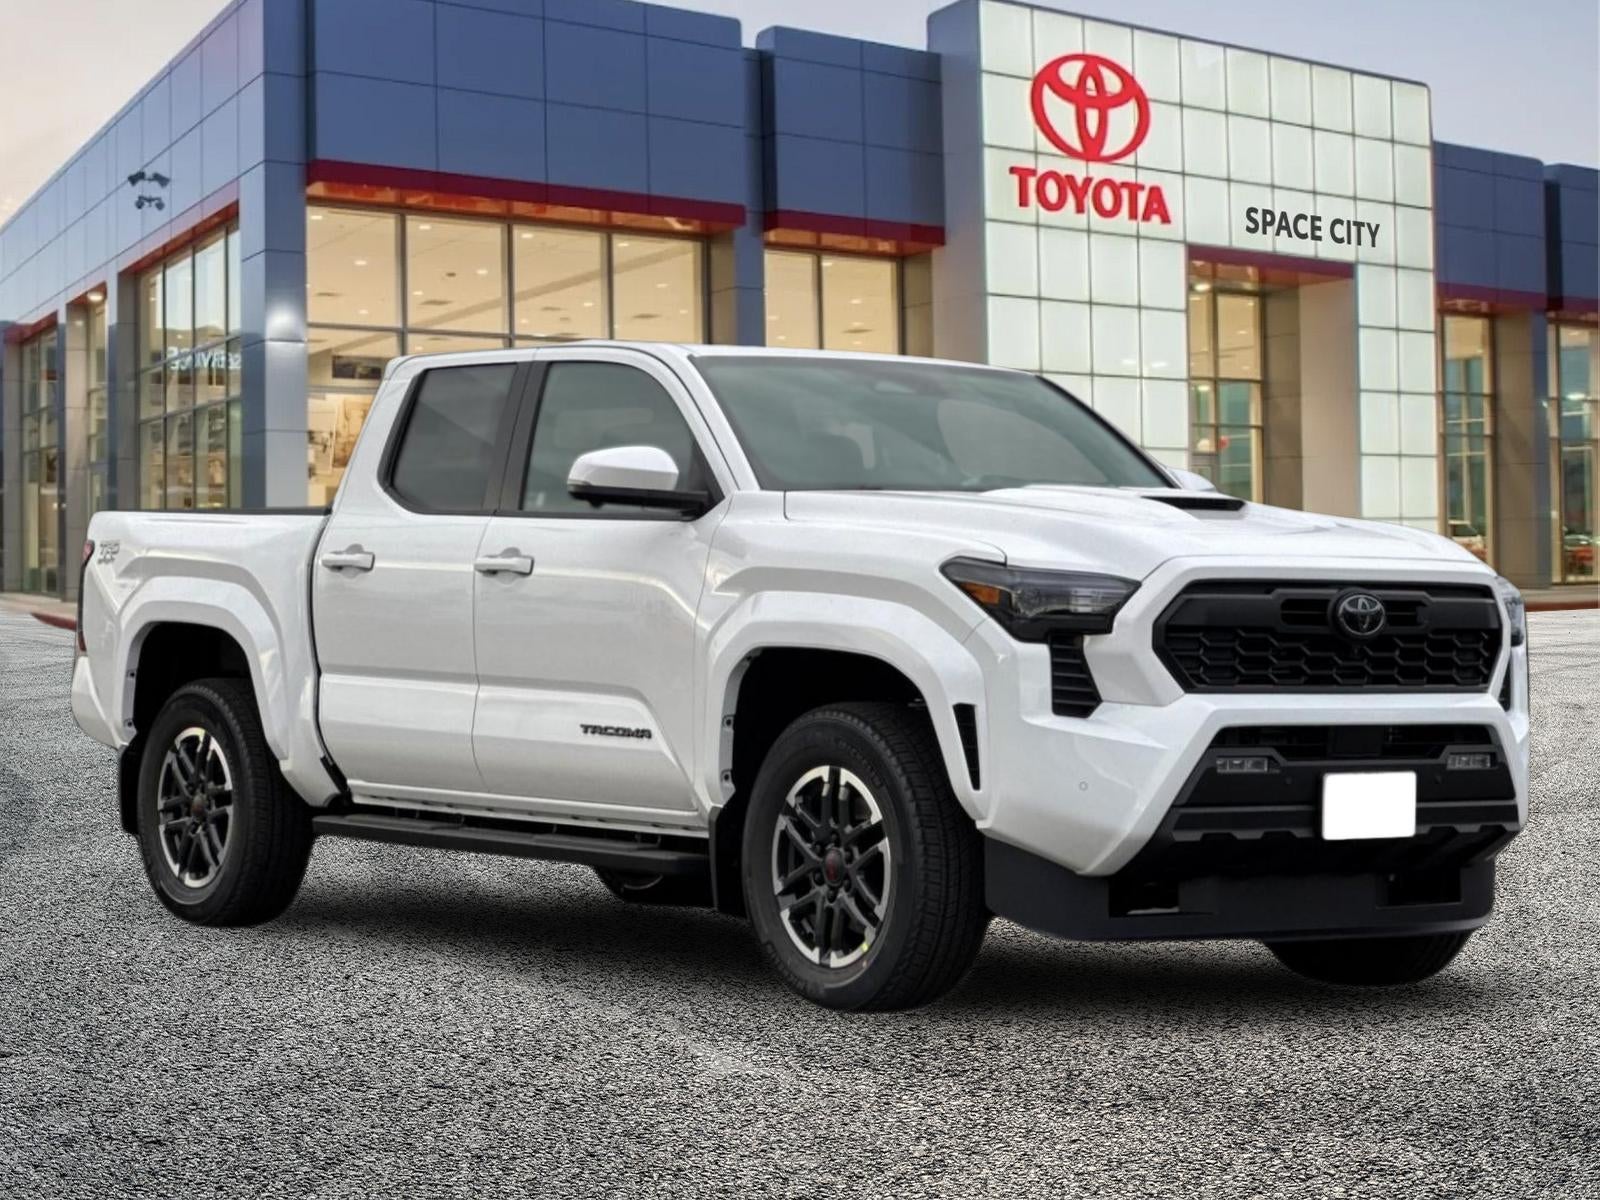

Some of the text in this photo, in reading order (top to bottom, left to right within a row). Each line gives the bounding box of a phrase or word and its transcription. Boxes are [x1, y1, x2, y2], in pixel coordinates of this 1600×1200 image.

[1009, 166, 1171, 224] TOYOTA
[1245, 206, 1381, 248] SPACE CITY
[580, 723, 653, 740] TACOMA
